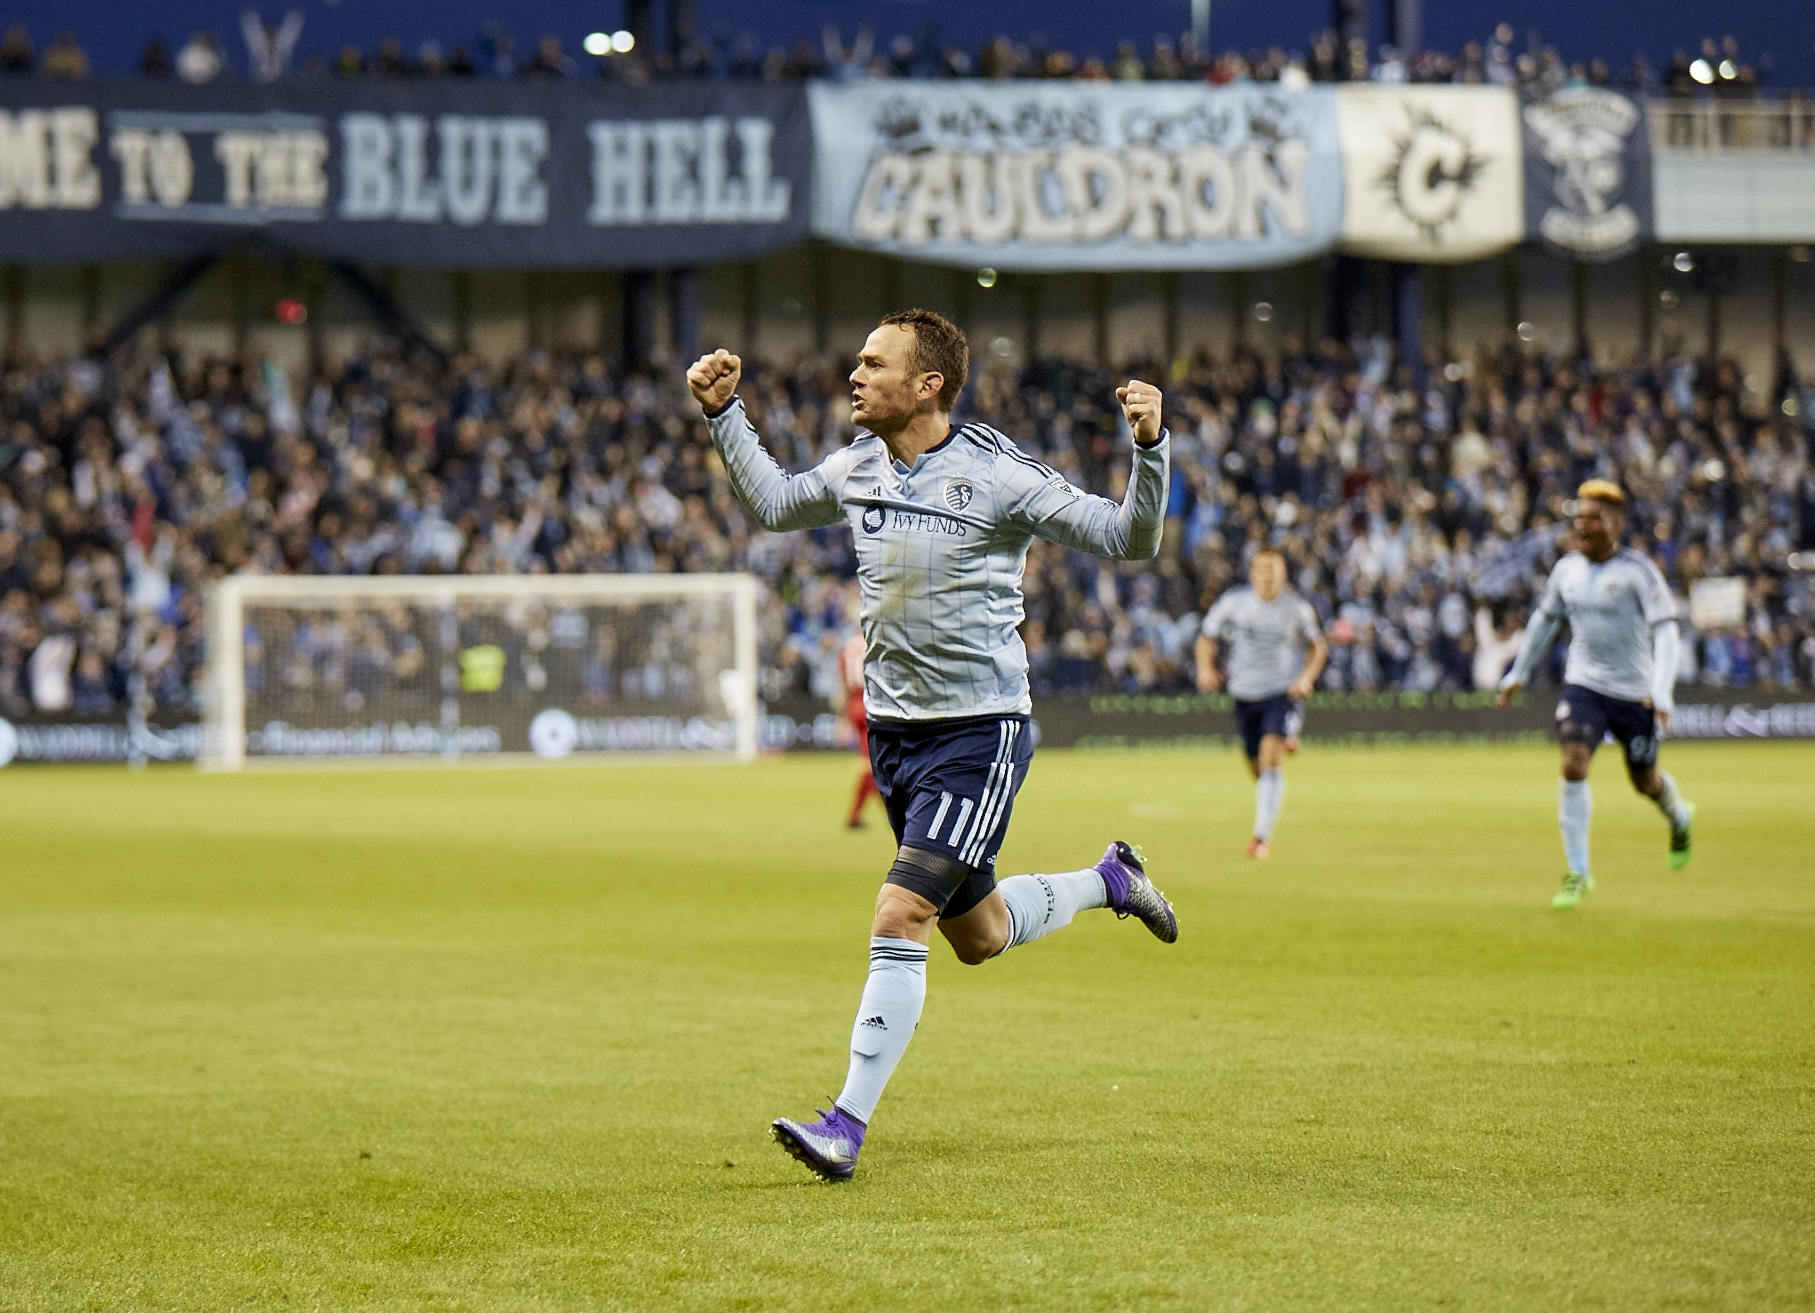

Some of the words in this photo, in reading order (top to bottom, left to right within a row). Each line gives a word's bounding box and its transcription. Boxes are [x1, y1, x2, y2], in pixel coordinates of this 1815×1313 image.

[110, 130, 194, 208] TO
[215, 130, 330, 210] THE
[339, 112, 549, 227] BLUE
[587, 115, 792, 226] HELL
[852, 137, 1313, 246] CAULDRON
[917, 512, 967, 537] FUNDS
[927, 791, 974, 847] 11
